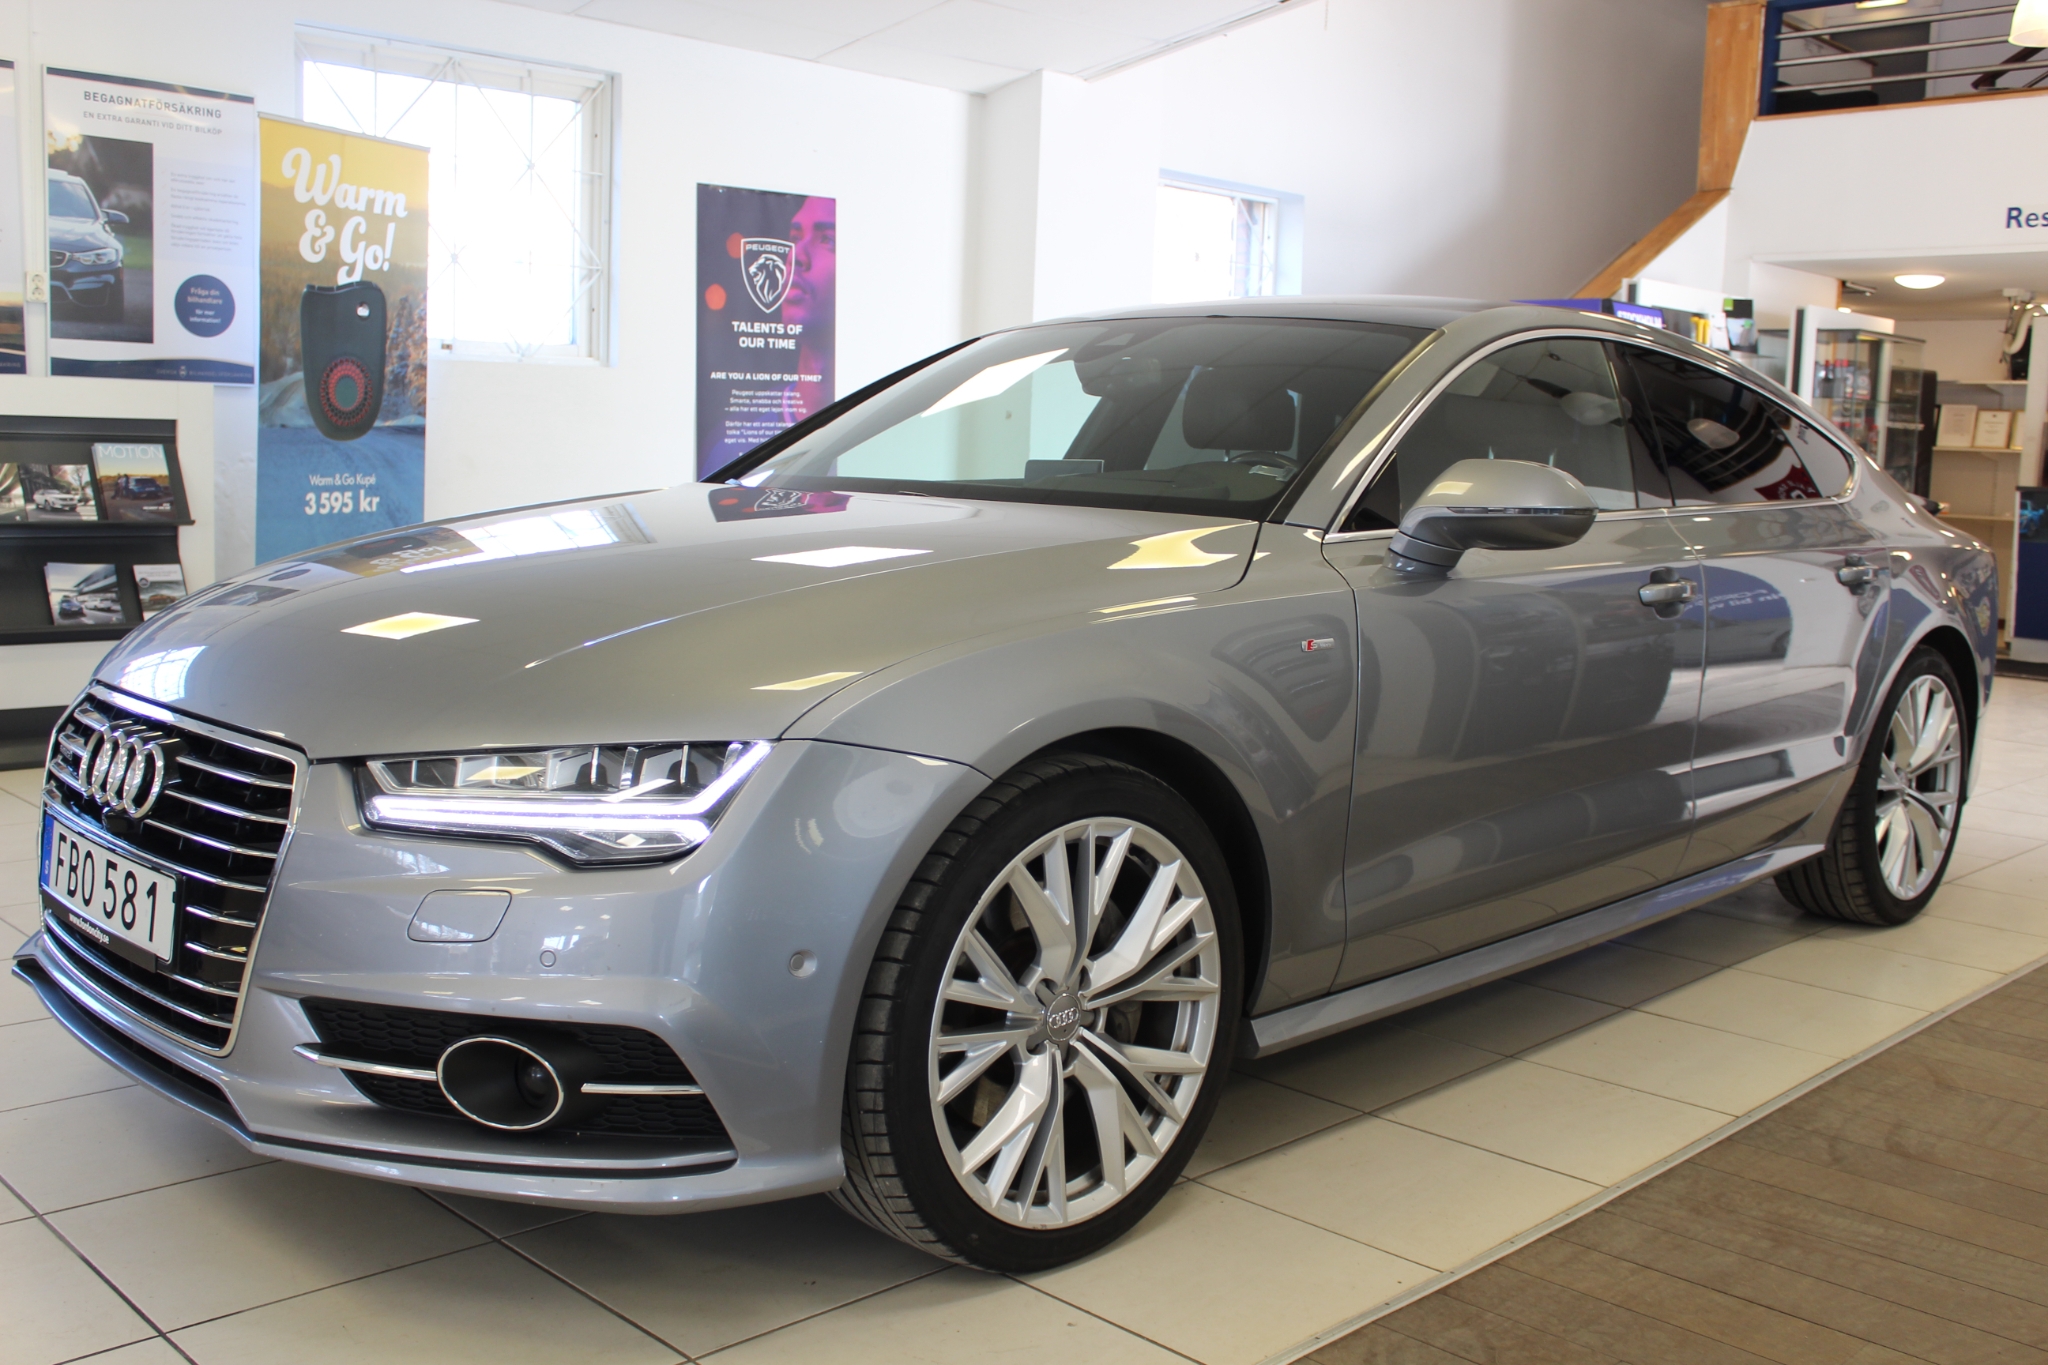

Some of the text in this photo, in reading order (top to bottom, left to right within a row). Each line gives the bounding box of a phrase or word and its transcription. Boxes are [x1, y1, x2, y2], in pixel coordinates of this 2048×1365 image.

[83, 91, 222, 118] BEGAGNATFÖRSÄKRING
[83, 111, 222, 135] EN EXTRA GARANTI VID DITT BILKÖP
[281, 146, 408, 218] Warm
[2006, 206, 2048, 229] Res
[298, 208, 335, 263] &
[337, 215, 396, 286] Go!
[745, 243, 791, 254] PEUGEOT
[731, 321, 803, 335] TALENTS OF
[739, 336, 796, 349] OUR TIME
[710, 371, 727, 379] ARE
[728, 372, 744, 380] YOU
[745, 372, 752, 380] A
[752, 373, 771, 381] LION
[771, 373, 782, 381] OF
[799, 374, 822, 382] TIME?
[98, 445, 163, 459] MOTION
[308, 474, 334, 486] Warm
[334, 473, 341, 486] &
[341, 473, 355, 486] Go
[359, 489, 380, 513] kr
[55, 831, 158, 944] FBO 581
